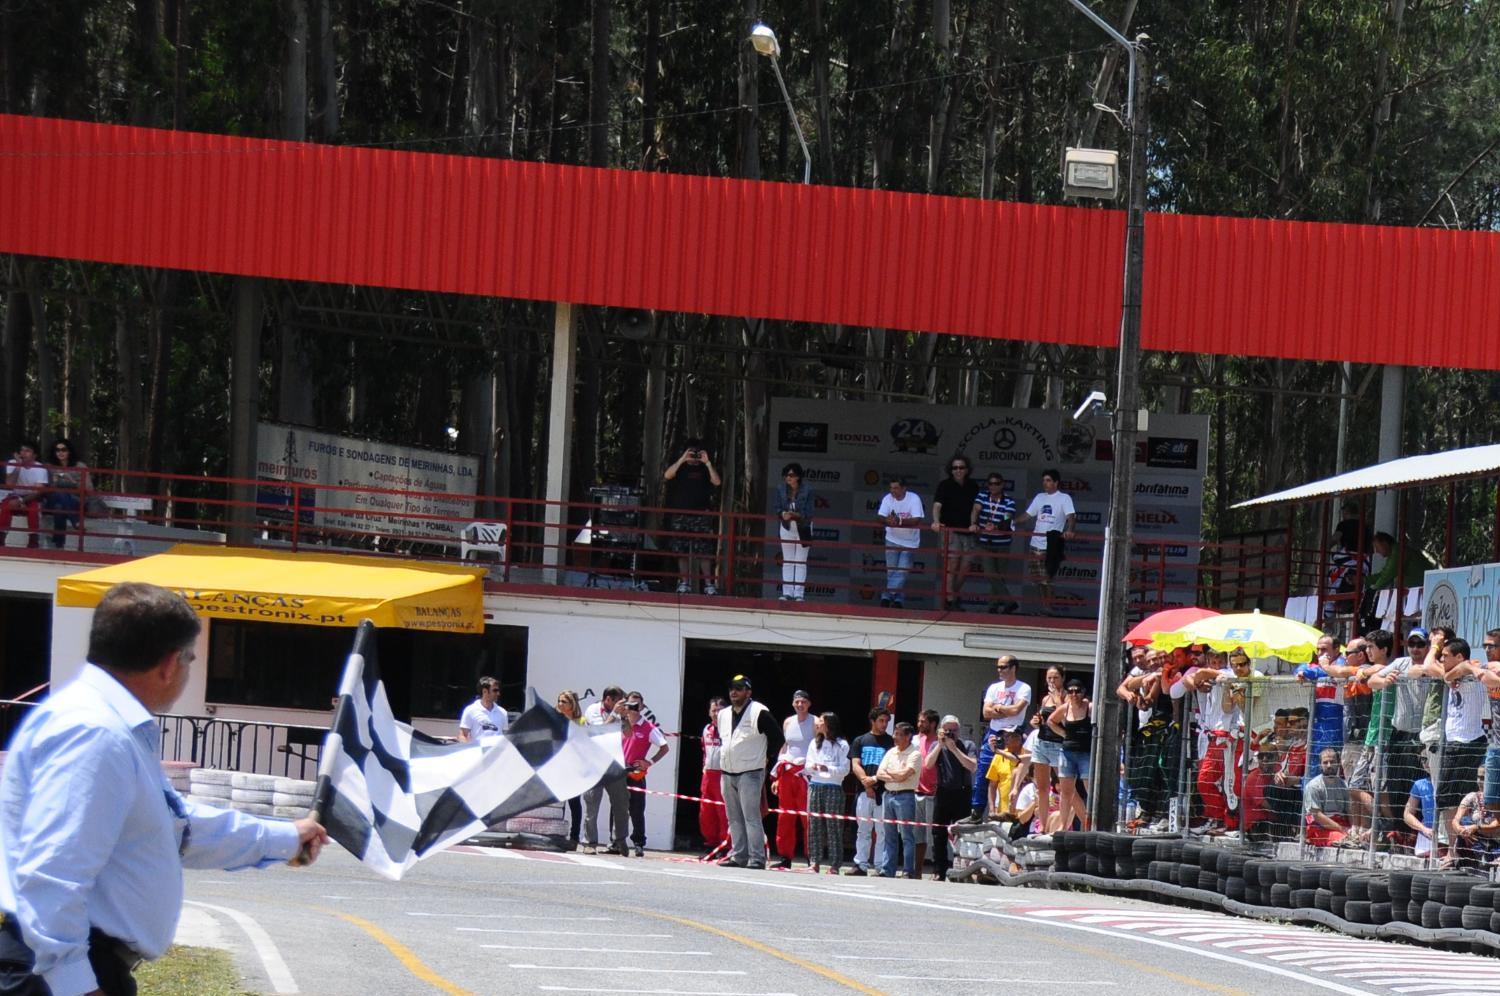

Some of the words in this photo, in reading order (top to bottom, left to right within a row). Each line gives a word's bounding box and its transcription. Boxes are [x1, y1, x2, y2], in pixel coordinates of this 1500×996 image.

[834, 433, 880, 443] HONDA
[898, 421, 926, 439] 24
[1005, 416, 1054, 461] KARTING
[308, 441, 337, 456] FUROS
[339, 448, 344, 457] E
[346, 449, 396, 466] SONDAGENS
[398, 457, 410, 467] DE
[978, 451, 1032, 461] EUROINDY
[413, 479, 423, 487] de
[1060, 480, 1089, 491] ELIX
[370, 496, 403, 510] Qualquer
[405, 502, 421, 513] Tipo
[1135, 512, 1177, 524] HELIX
[179, 590, 304, 609] ALANÇAS
[195, 604, 346, 624] pestronix.pt
